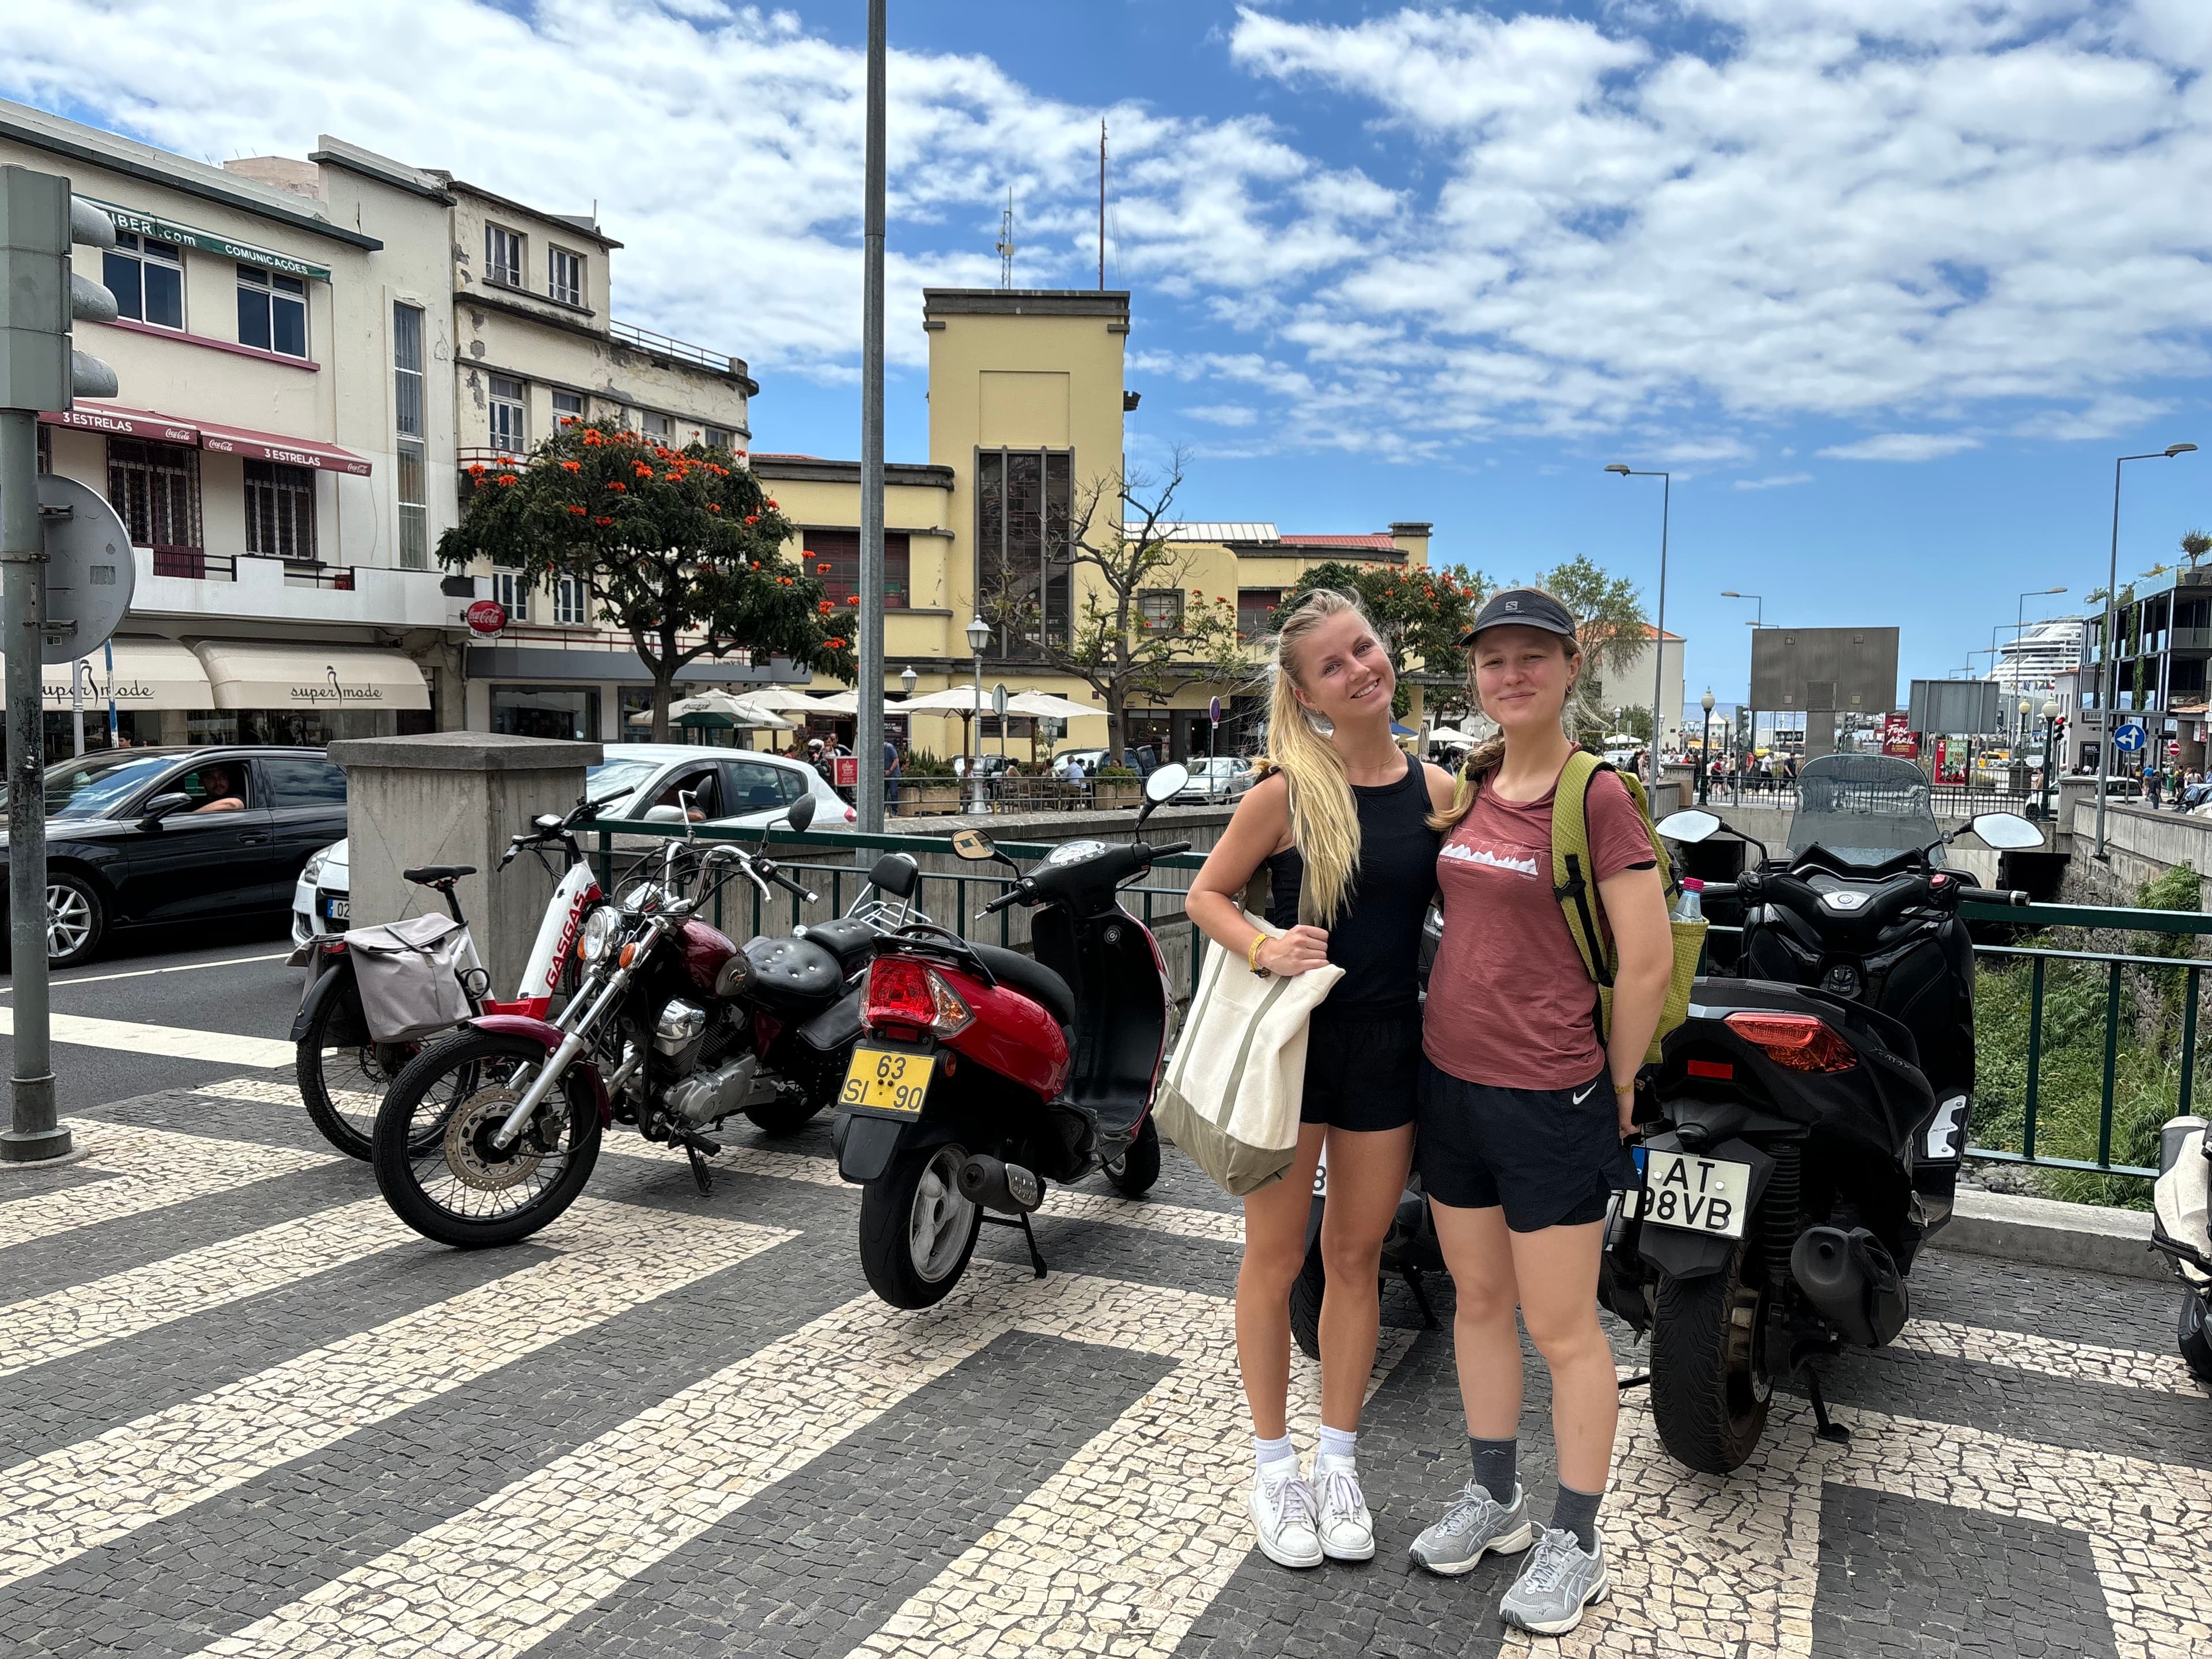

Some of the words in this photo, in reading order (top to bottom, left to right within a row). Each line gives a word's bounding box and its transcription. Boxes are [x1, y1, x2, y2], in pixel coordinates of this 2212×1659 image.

[104, 210, 153, 234] IBER
[225, 244, 309, 275] COMUNICAÇÕES
[62, 411, 70, 423] 3
[73, 413, 133, 432] ESTRELAS
[264, 448, 271, 458] 3
[272, 450, 321, 467] ESTRELAS
[41, 685, 92, 704] uper
[291, 687, 337, 704] super
[343, 683, 383, 698] mode
[337, 902, 350, 918] 02
[545, 890, 586, 989] GASGAS
[877, 1055, 906, 1080] 63
[843, 1078, 869, 1103] SI
[893, 1085, 923, 1109] 90
[1662, 1157, 1715, 1193] AT
